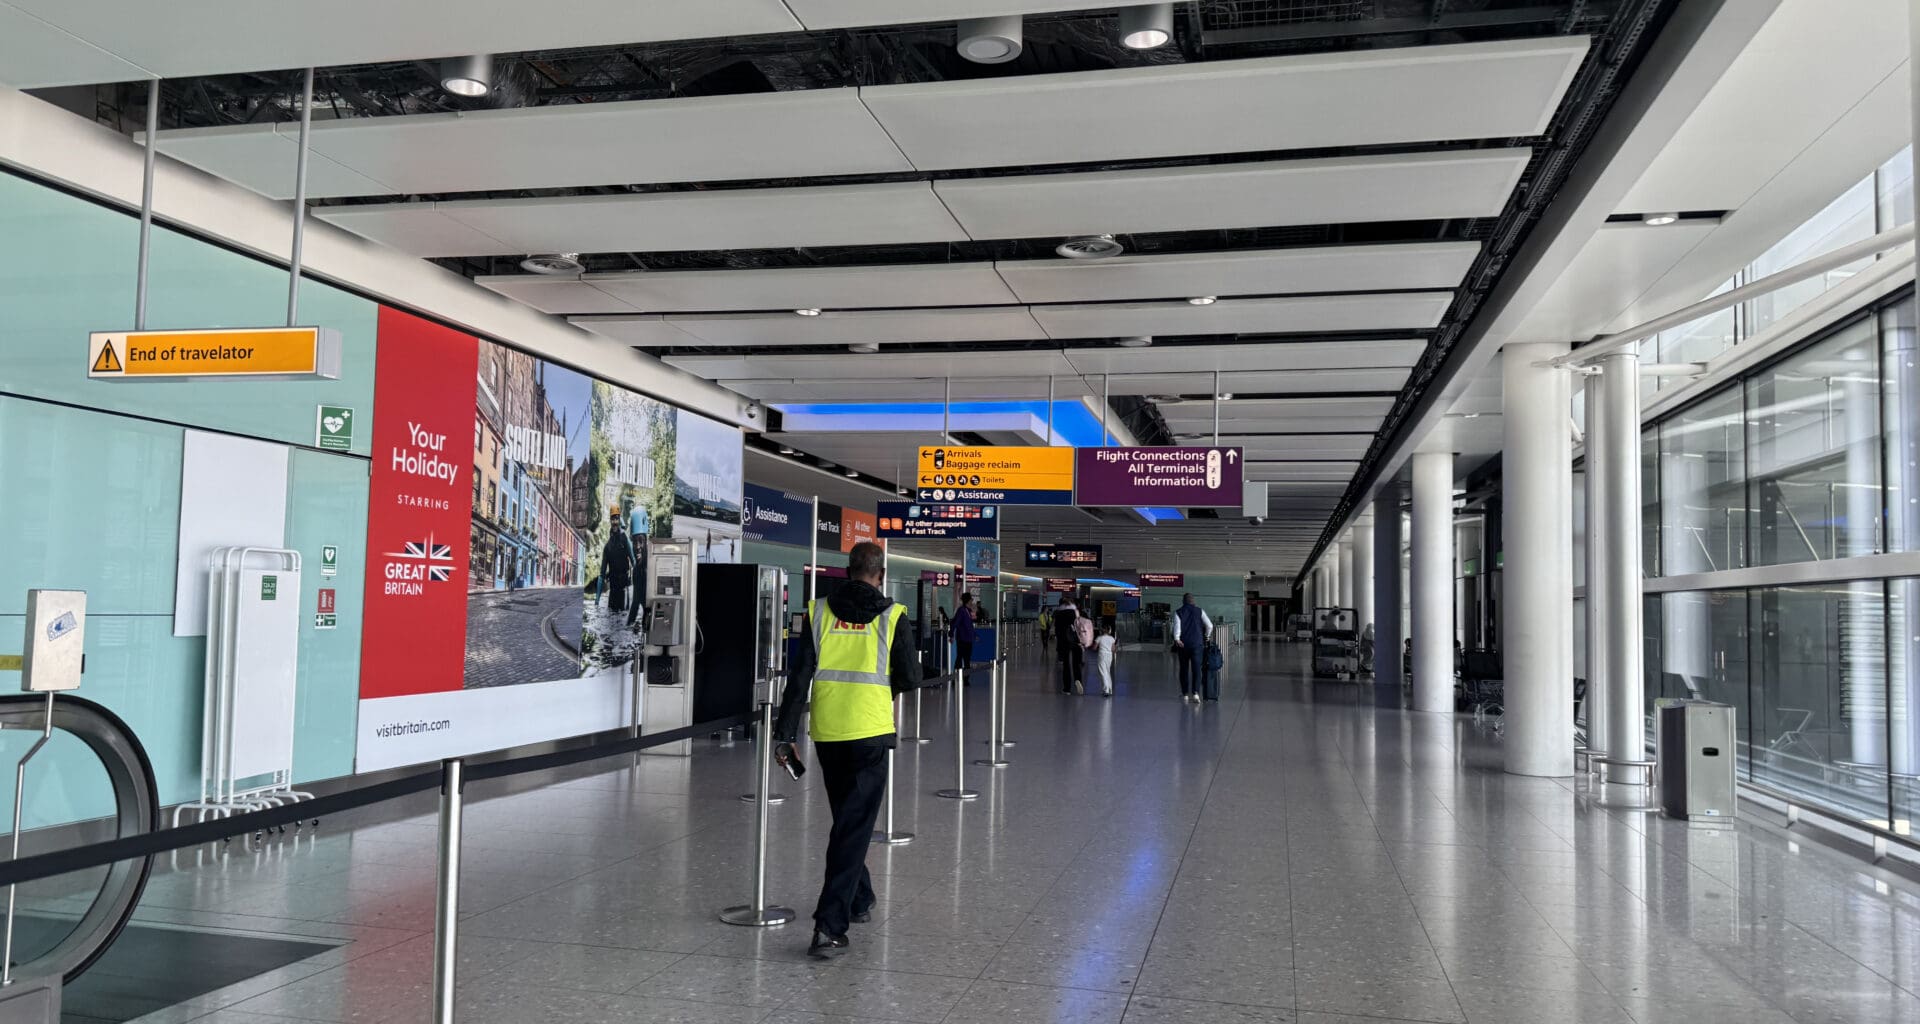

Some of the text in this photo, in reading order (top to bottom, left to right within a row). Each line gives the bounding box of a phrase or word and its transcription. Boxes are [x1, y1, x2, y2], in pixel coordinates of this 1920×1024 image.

[130, 345, 254, 361] End of travelator
[408, 421, 446, 451] Your
[505, 423, 567, 471] SCOTLAND
[946, 450, 982, 458] Arrivals
[1097, 451, 1205, 463] Flight Connections
[392, 447, 458, 486] Holiday
[614, 450, 655, 489] ENGLAND
[946, 460, 1021, 470] Baggage reclaim
[1128, 464, 1205, 473] All Terminals
[1134, 476, 1205, 486] Information
[397, 494, 449, 510] STARRING
[957, 490, 1004, 499] Assistance
[755, 505, 788, 525] Assistance
[818, 519, 840, 534] Fast Track
[860, 522, 871, 533] other
[385, 562, 426, 581] GREAT
[384, 582, 423, 595] BRITAIN
[376, 718, 450, 738] visitbritain.com
